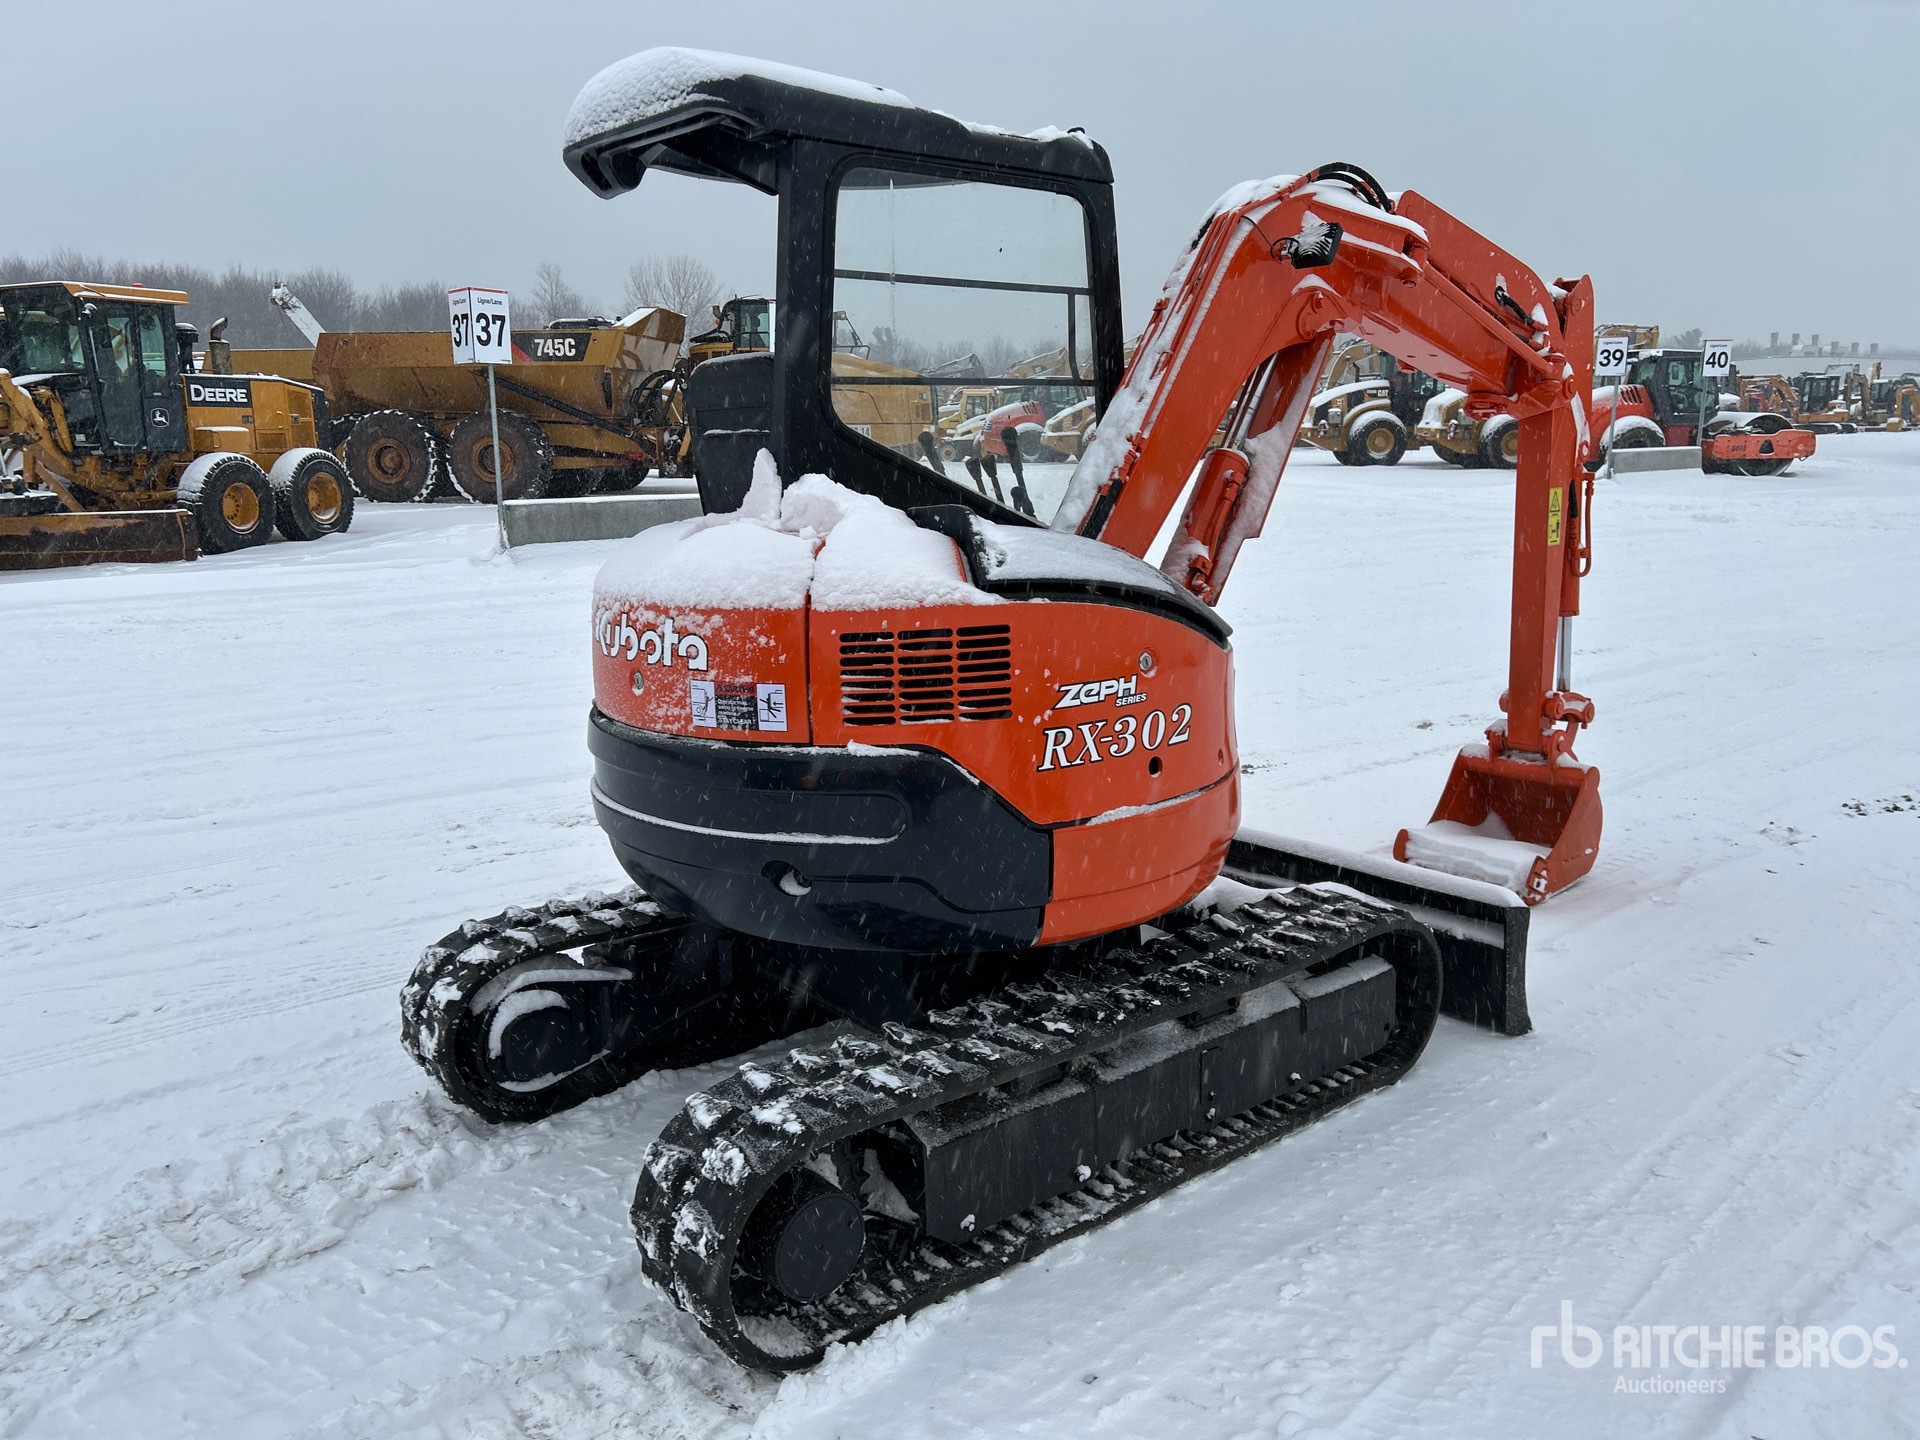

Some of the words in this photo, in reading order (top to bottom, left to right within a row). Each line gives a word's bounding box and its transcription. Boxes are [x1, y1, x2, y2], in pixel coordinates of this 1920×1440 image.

[477, 297, 503, 305] Ligne/Lane
[452, 313, 469, 347] 37
[475, 312, 506, 347] 37
[534, 338, 576, 356] 745C
[1599, 349, 1625, 367] 39
[1705, 351, 1729, 368] 40
[190, 384, 248, 402] DEERE
[595, 611, 709, 672] Kubota
[1115, 693, 1148, 707] SERIES
[1036, 702, 1193, 773] RX-302
